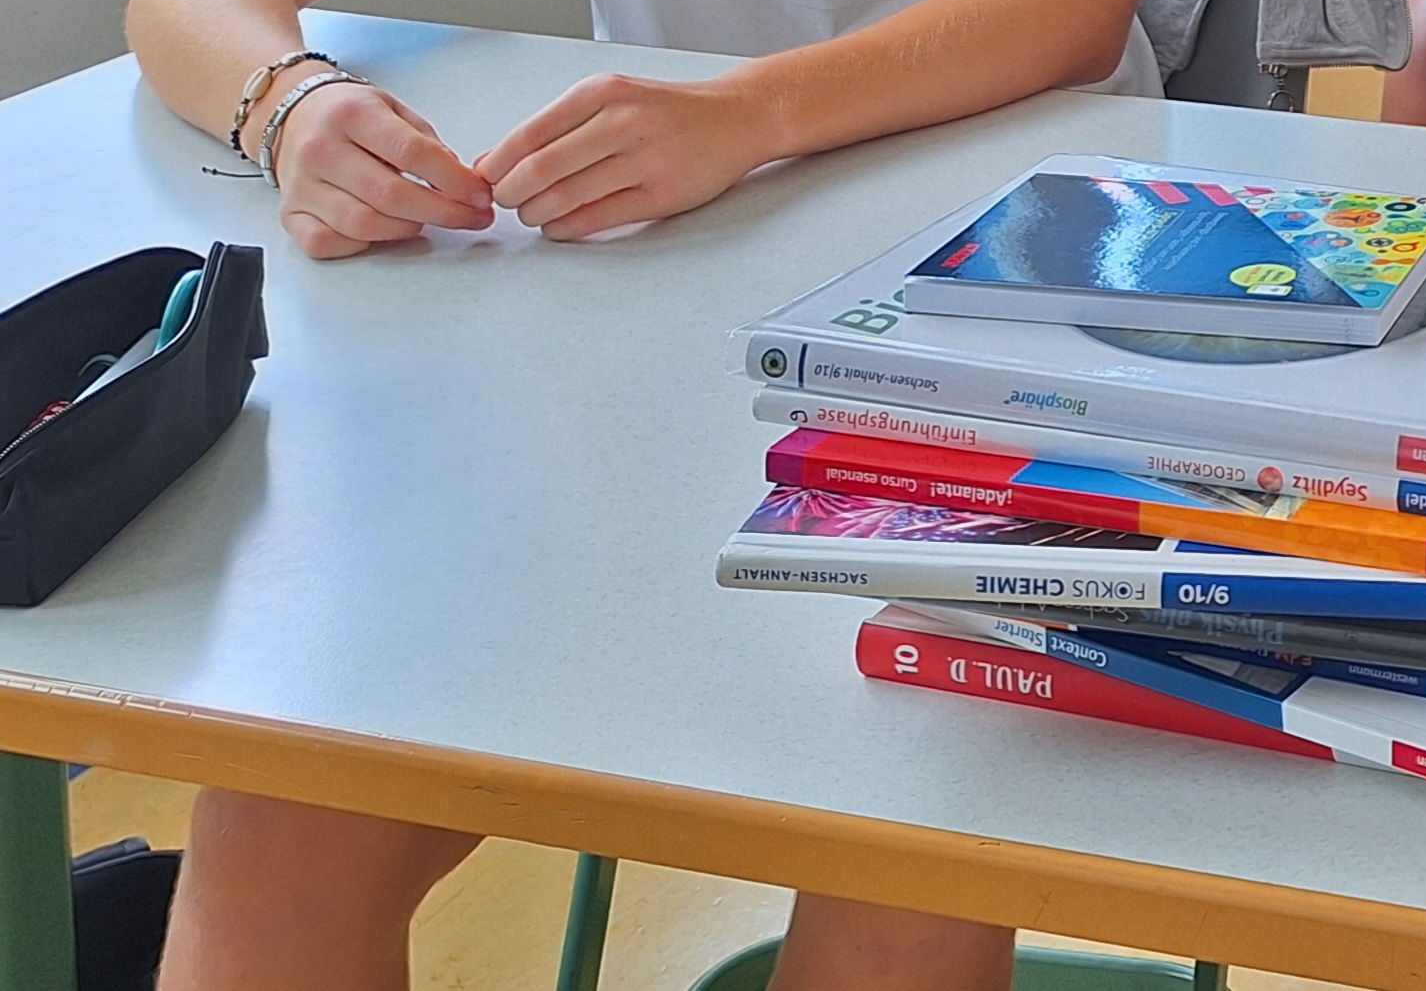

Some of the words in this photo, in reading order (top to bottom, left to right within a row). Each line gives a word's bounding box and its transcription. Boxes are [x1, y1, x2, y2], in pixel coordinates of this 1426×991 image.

[829, 289, 904, 335] Bi
[843, 366, 939, 393] Sachsen-Anhalt
[1010, 390, 1088, 416] Biosphäre
[817, 407, 976, 446] Einführungsphase
[826, 467, 878, 485] esencial
[1147, 456, 1246, 483] GEOGRAPHIE
[881, 474, 917, 493] Curso
[930, 481, 1013, 506] ¡Adelante!
[1292, 474, 1367, 501] Seydlitz
[733, 568, 869, 586] SACHSEN-ANHALT
[974, 575, 1065, 598] CHEMIE
[1178, 582, 1230, 605] 9/10
[994, 620, 1045, 648] Starter
[1202, 612, 1284, 645] Physik
[894, 644, 920, 675] 10
[1050, 635, 1108, 668] Context
[1347, 664, 1418, 687] westermann
